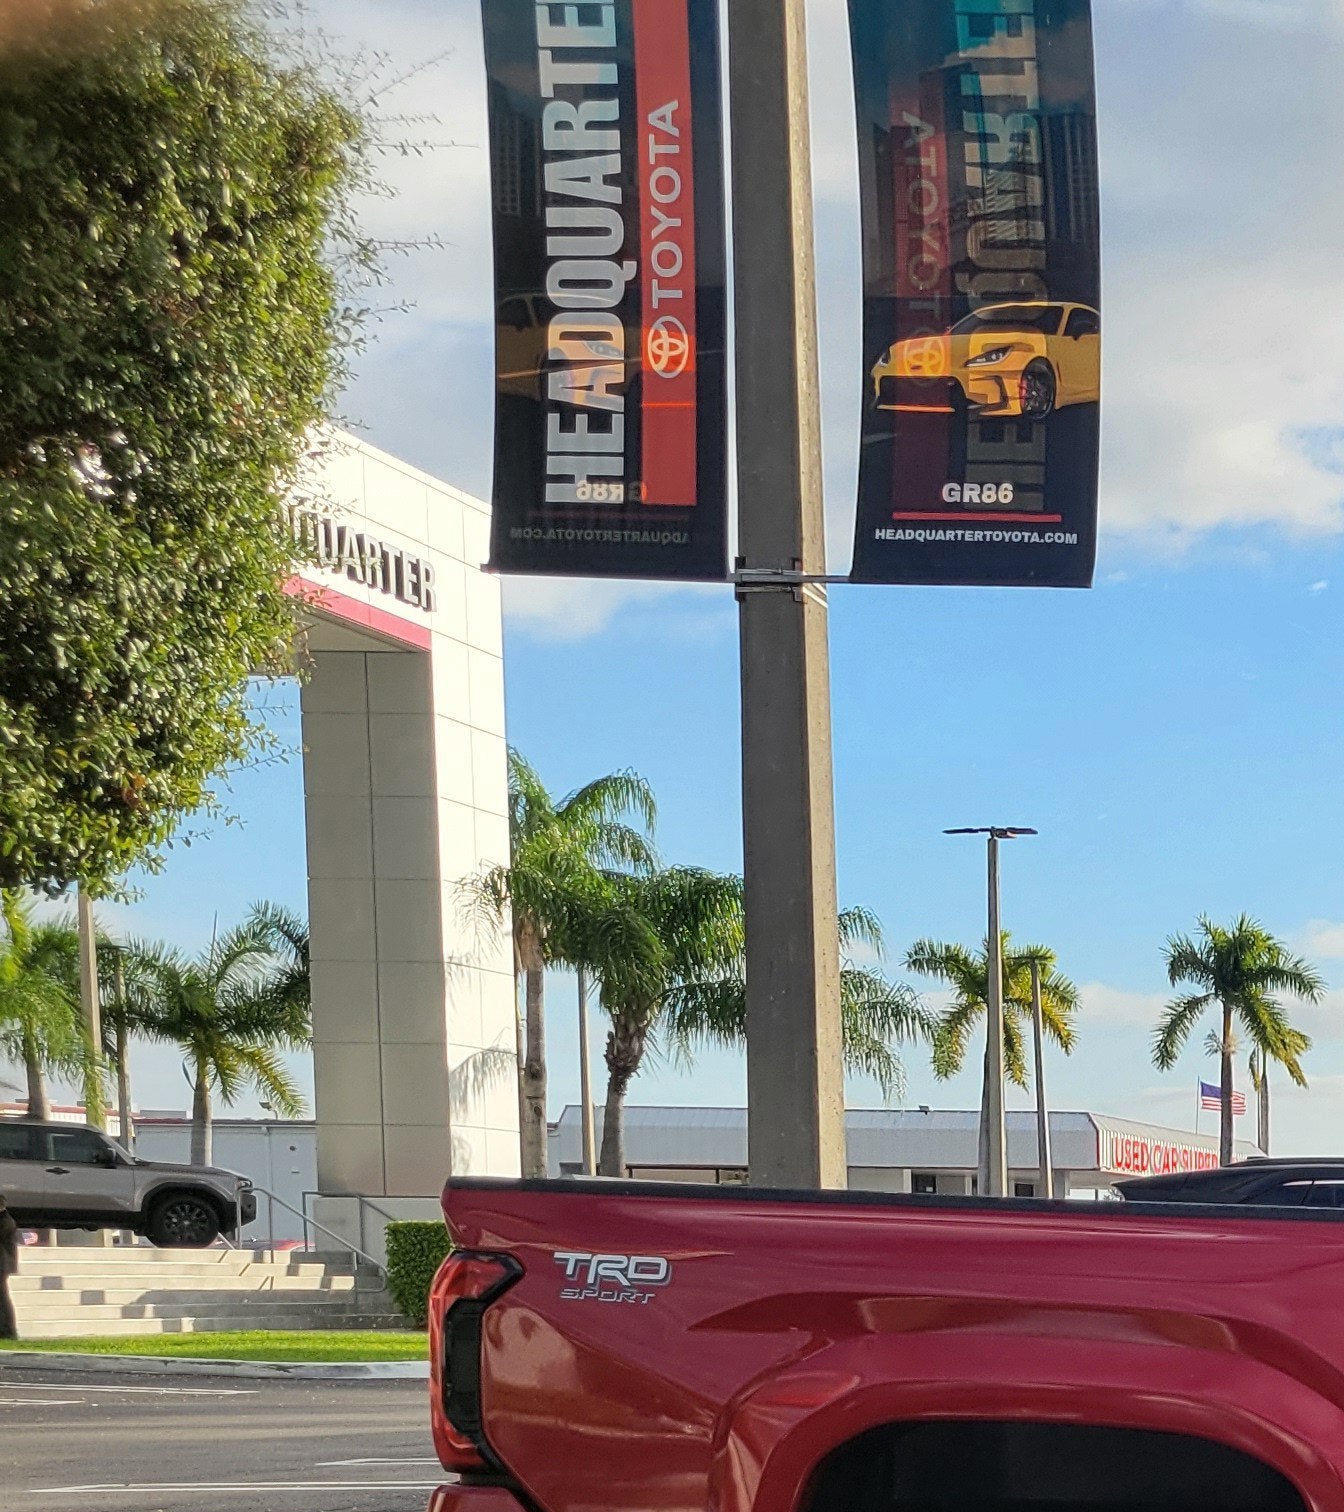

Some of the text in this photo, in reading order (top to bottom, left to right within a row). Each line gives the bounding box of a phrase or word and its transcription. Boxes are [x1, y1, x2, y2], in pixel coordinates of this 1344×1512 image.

[648, 100, 684, 310] TOYOTA
[536, 0, 637, 505] HEADQUARTE
[942, 482, 1014, 505] GR86
[875, 528, 1077, 544] HEADQUARTERTOYOTA.COM
[1114, 1137, 1149, 1170] USED
[1152, 1145, 1178, 1173] CAR
[553, 1251, 671, 1286] TRD
[560, 1288, 655, 1303] SPORT
